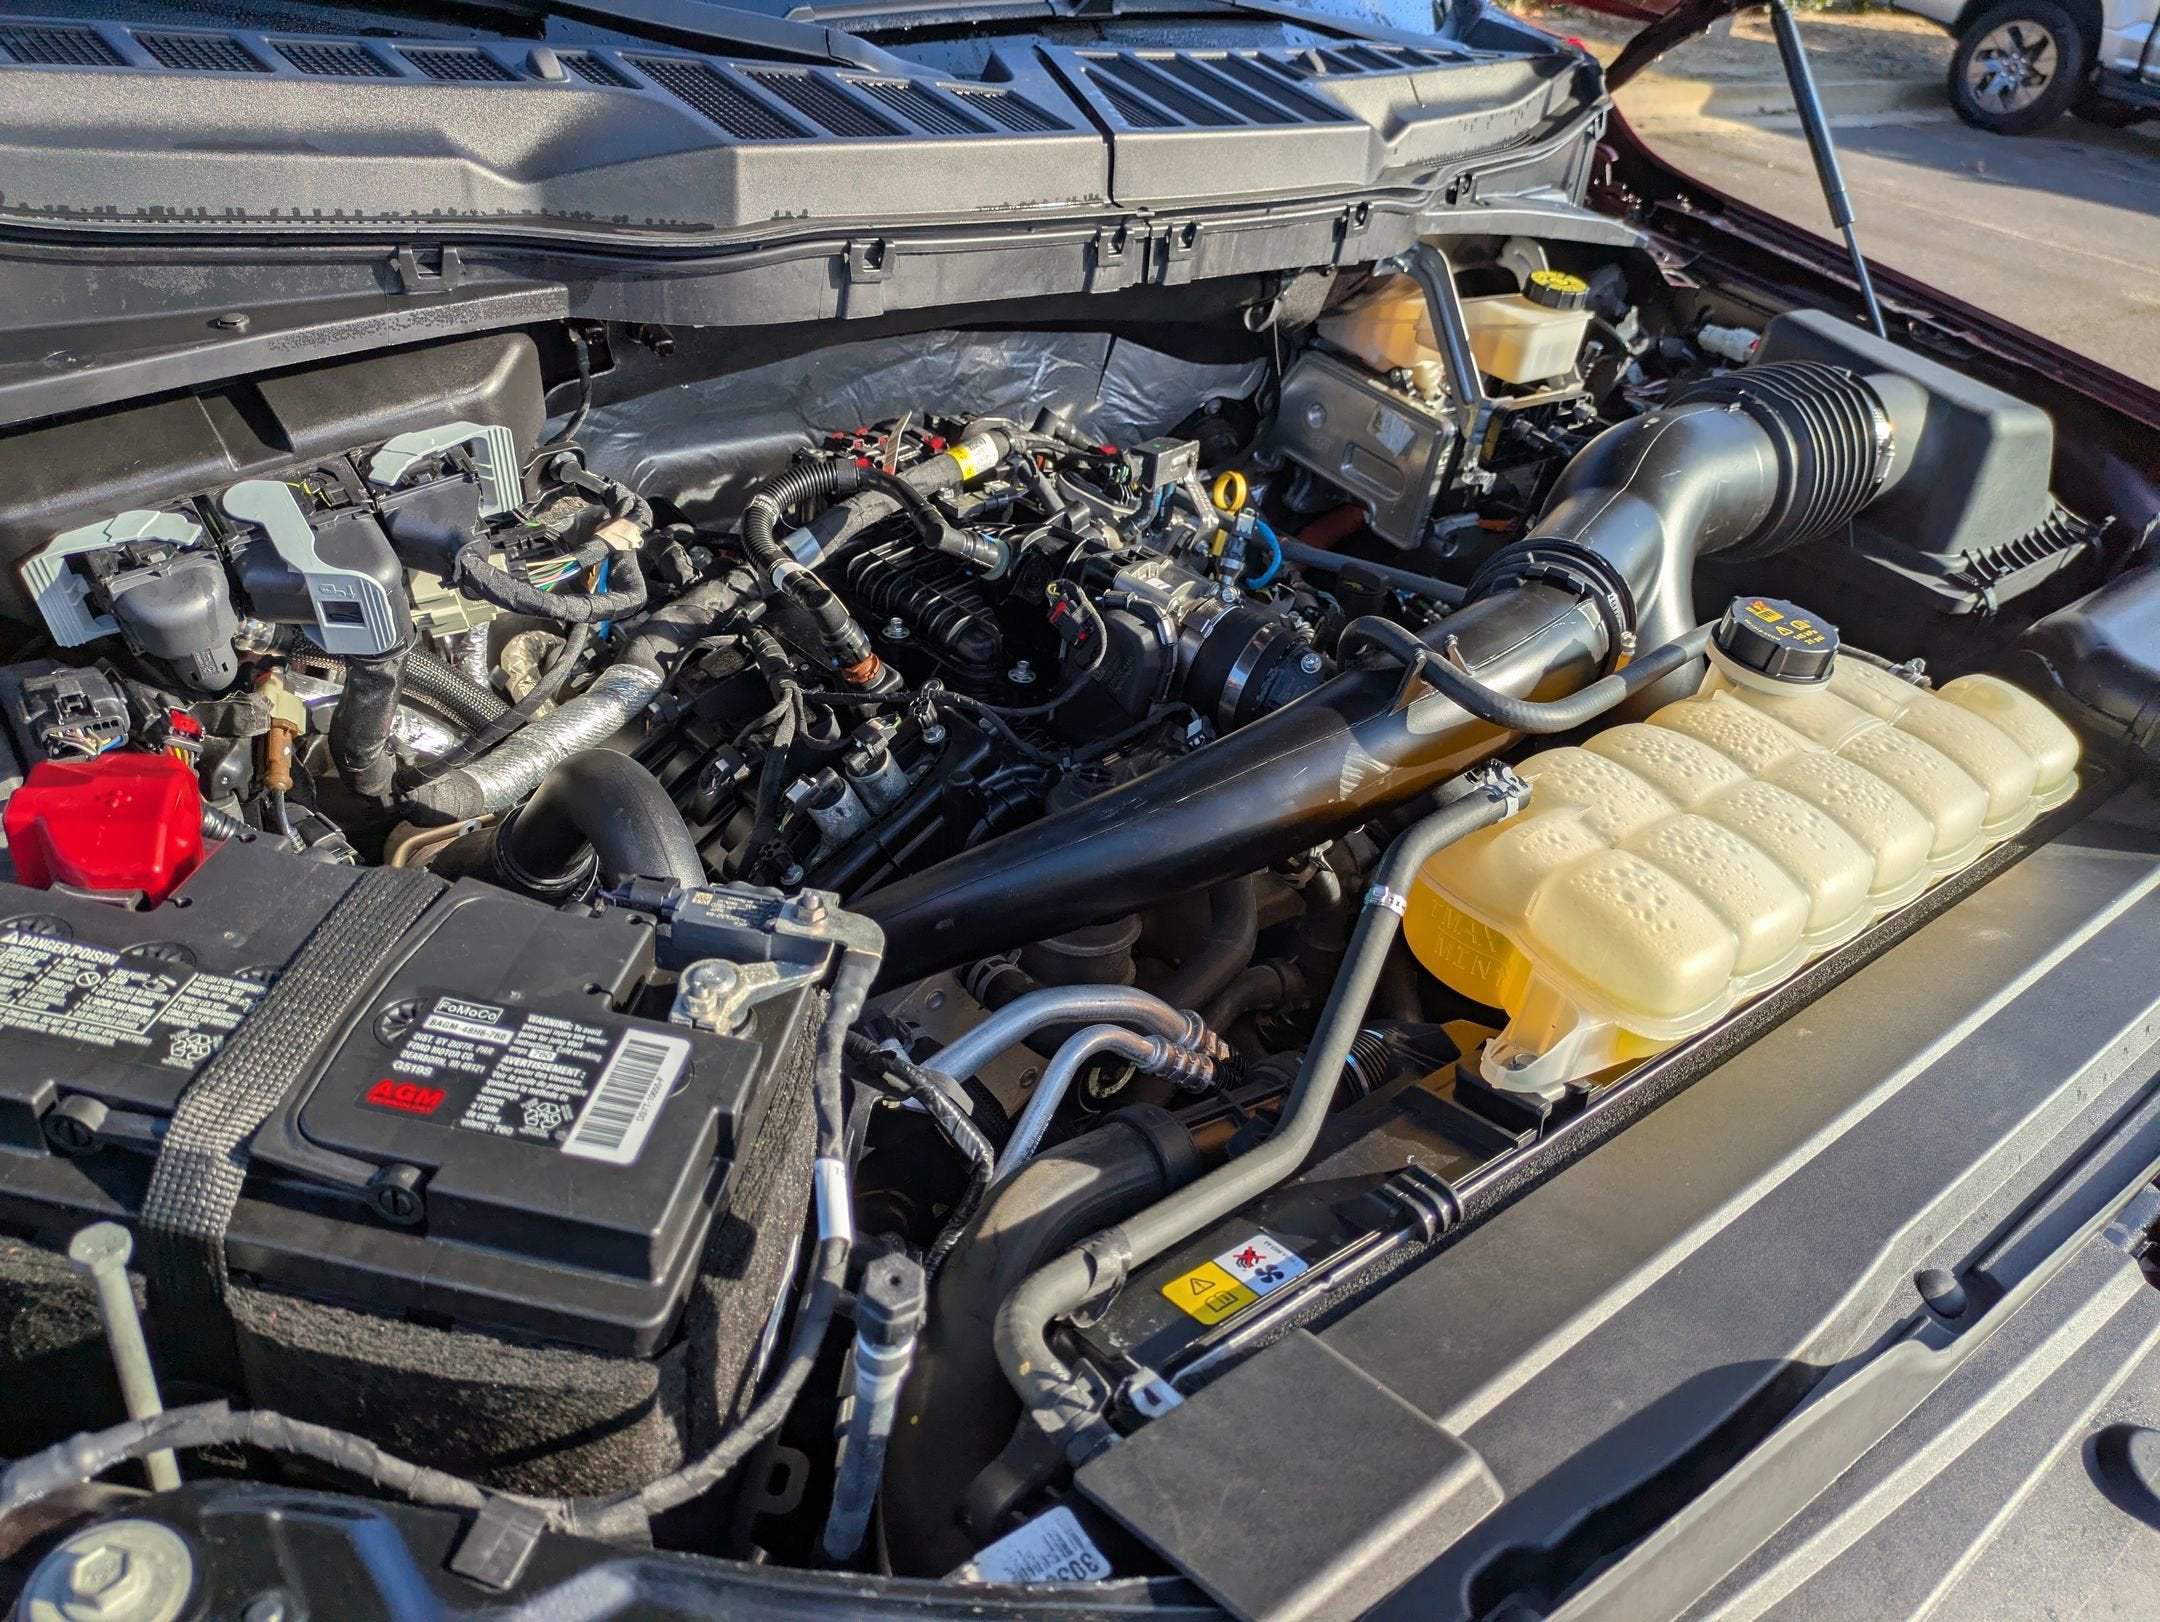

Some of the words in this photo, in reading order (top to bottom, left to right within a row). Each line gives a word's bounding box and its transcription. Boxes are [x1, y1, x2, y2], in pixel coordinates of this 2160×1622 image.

[18, 935, 120, 966] DANGER/POISON
[1433, 936, 1493, 981] MIN
[438, 1002, 496, 1021] FoMoCo
[522, 1024, 552, 1035] personal
[528, 1014, 574, 1030] WARNING:
[583, 1028, 602, 1037] avoid
[407, 1041, 430, 1052] FORD
[431, 1047, 460, 1058] MOTOR
[435, 1037, 448, 1046] BY
[476, 1046, 494, 1055] PAR
[501, 1055, 581, 1077] AVERTISSEMENT
[368, 1078, 446, 1105] AGM
